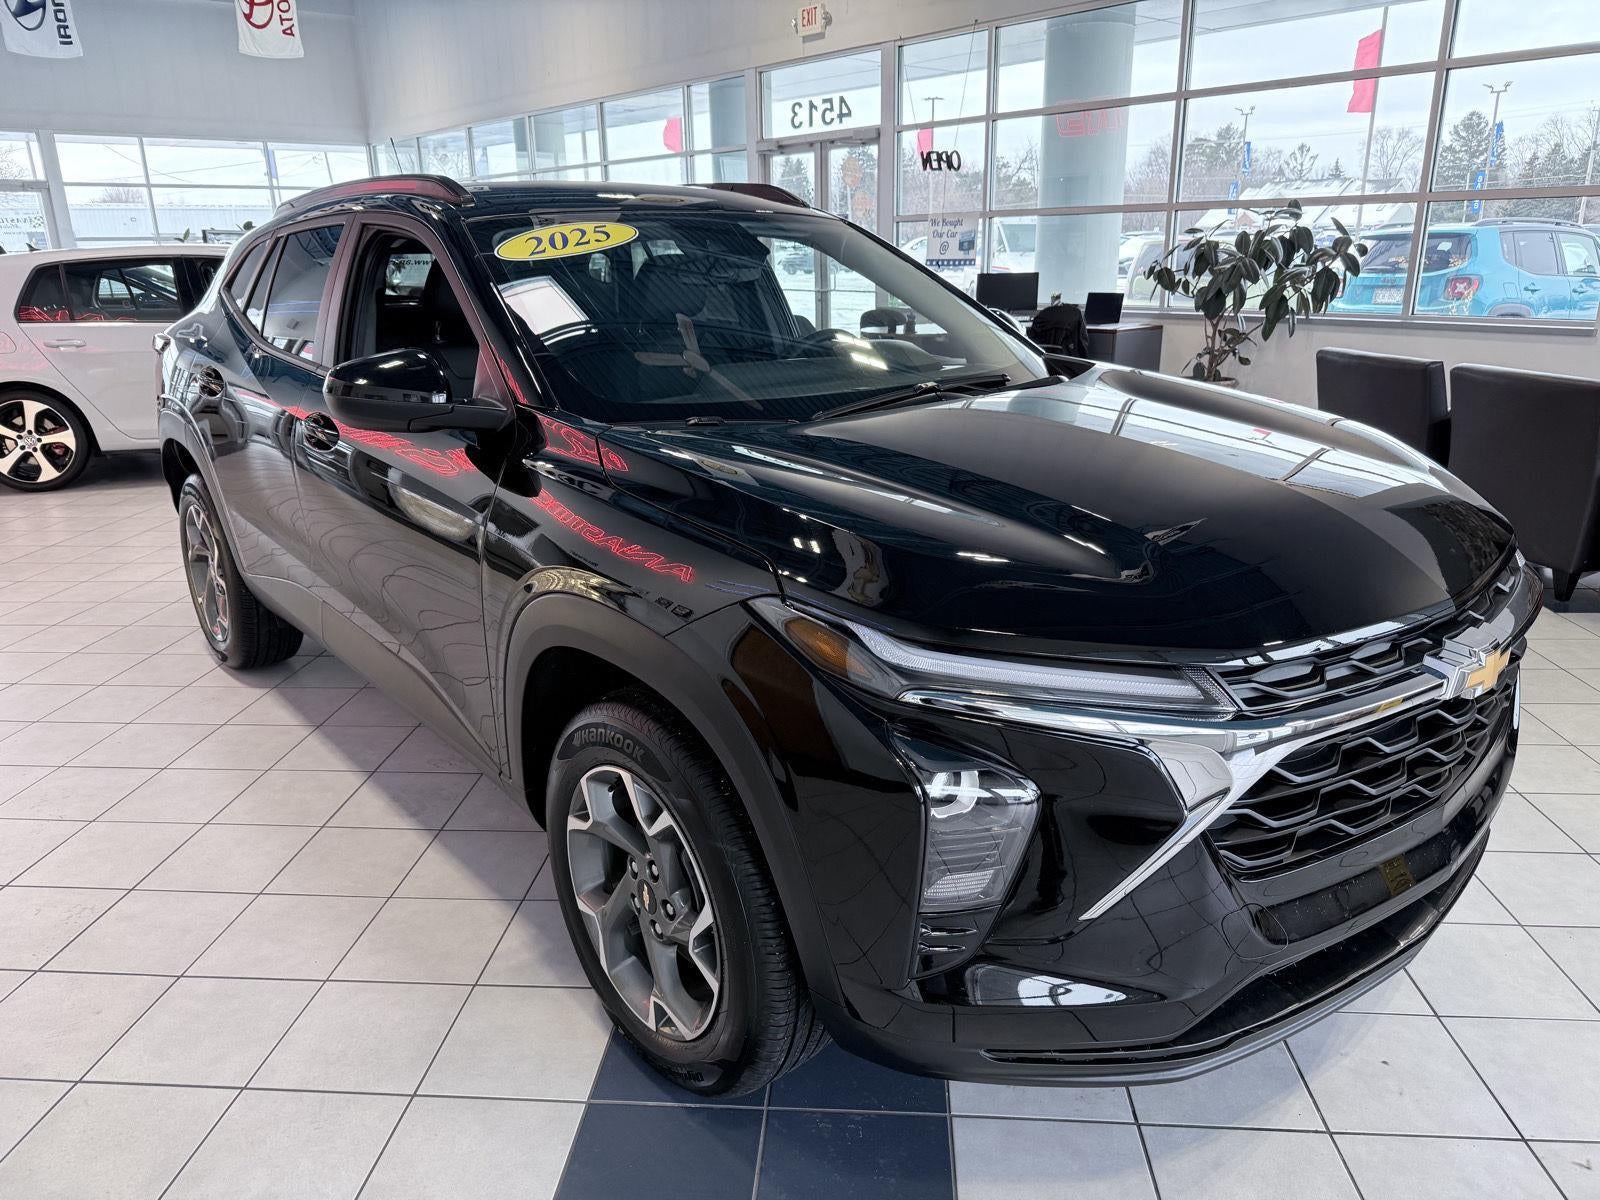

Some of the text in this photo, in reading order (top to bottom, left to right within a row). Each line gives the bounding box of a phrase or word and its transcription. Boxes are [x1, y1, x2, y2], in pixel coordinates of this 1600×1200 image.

[801, 6, 818, 27] EXIT
[930, 217, 964, 229] We Bought
[524, 224, 612, 257] 2025
[932, 229, 958, 238] Our Car
[939, 240, 950, 255] @
